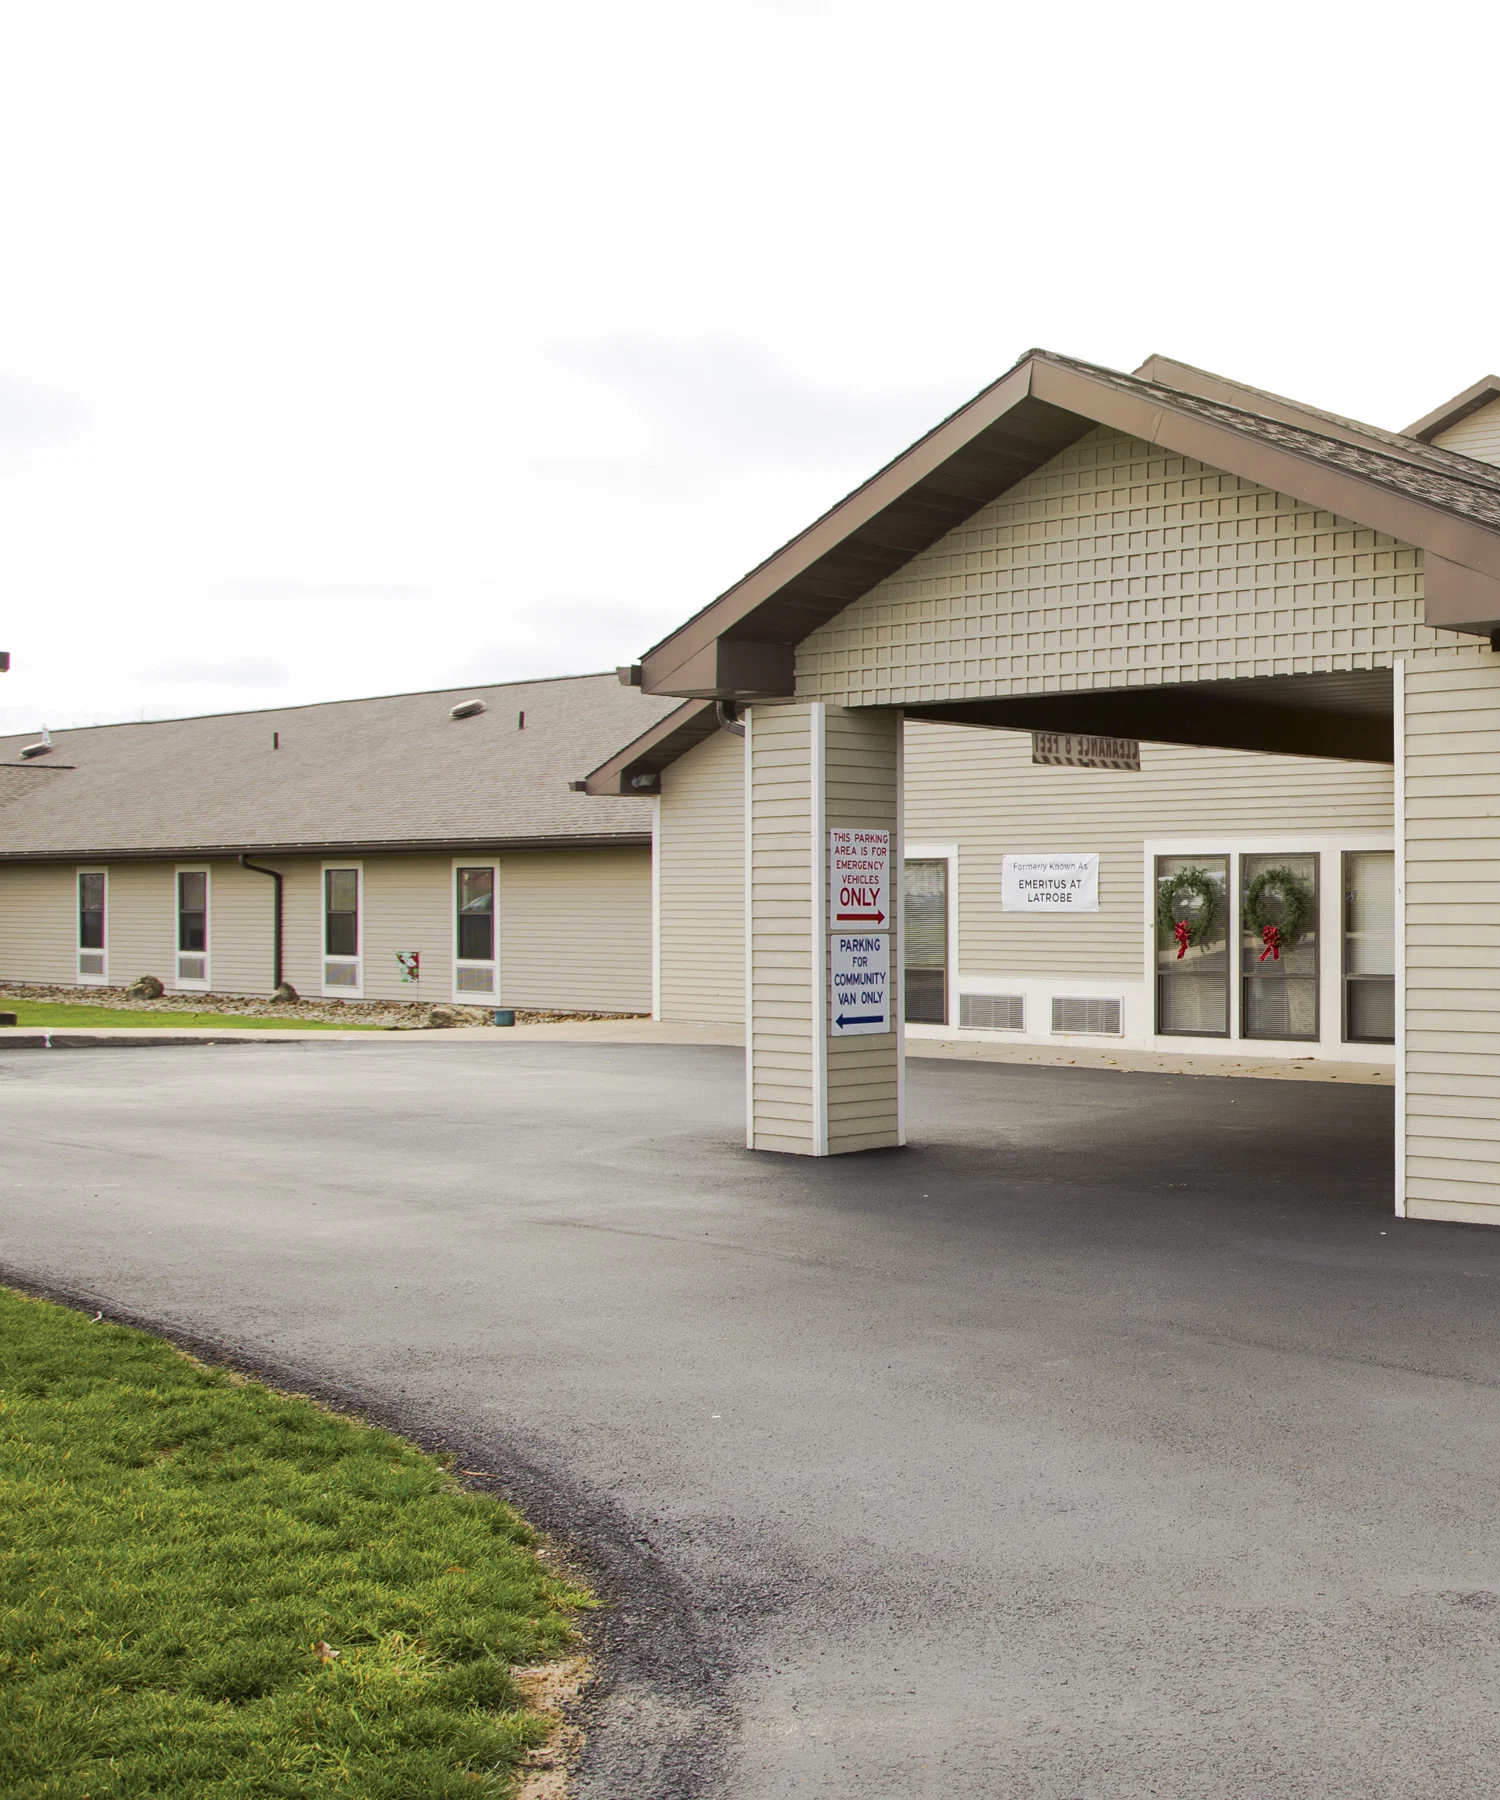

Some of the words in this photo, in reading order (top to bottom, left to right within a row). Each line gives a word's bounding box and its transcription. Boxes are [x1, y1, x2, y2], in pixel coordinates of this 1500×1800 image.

[833, 832, 851, 842] THIS
[854, 833, 888, 844] PARKING
[834, 845, 857, 855] AREA
[860, 846, 868, 856] IS
[871, 847, 887, 856] FOR
[836, 860, 884, 870] EMERGENCY
[1013, 862, 1047, 872] Formerly
[1049, 862, 1075, 870] Known
[1078, 862, 1088, 870] As
[841, 874, 880, 884] VEHICLES
[1018, 879, 1066, 889] EMERITUS
[1069, 879, 1082, 889] AT
[840, 887, 881, 906] ONLY
[1027, 892, 1072, 902] LATROBE
[840, 938, 880, 952] PARKING
[852, 956, 868, 967] FOR
[834, 972, 886, 986] COMMUNITY
[838, 992, 856, 1005] VAN
[861, 991, 883, 1004] ONLY
